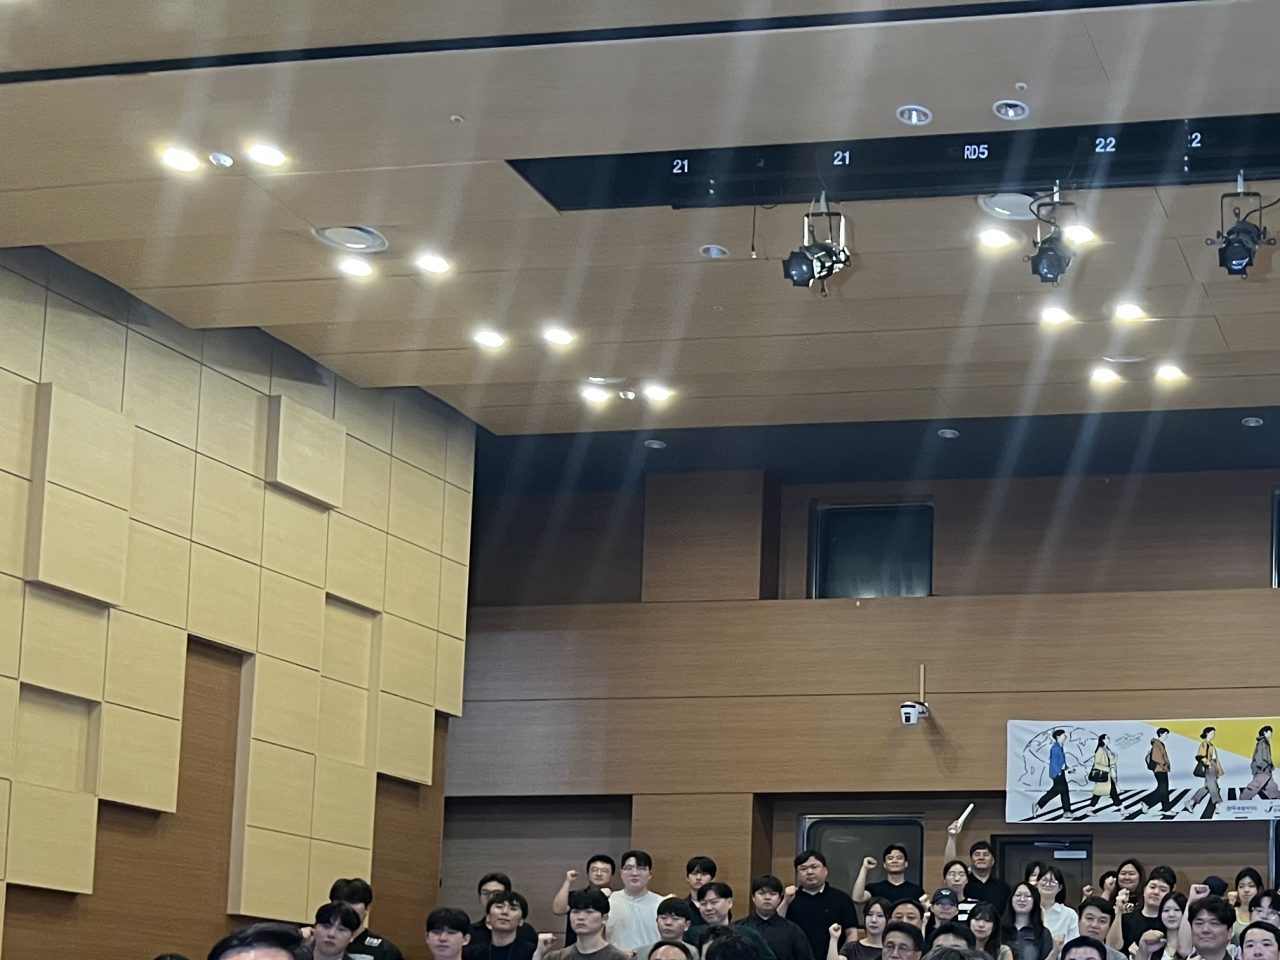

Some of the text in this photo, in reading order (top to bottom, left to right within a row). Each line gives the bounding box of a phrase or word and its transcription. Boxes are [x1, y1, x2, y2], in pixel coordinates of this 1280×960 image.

[964, 144, 989, 160] RD5
[1095, 136, 1116, 153] 22
[833, 150, 850, 165] 21
[672, 159, 688, 174] 21
